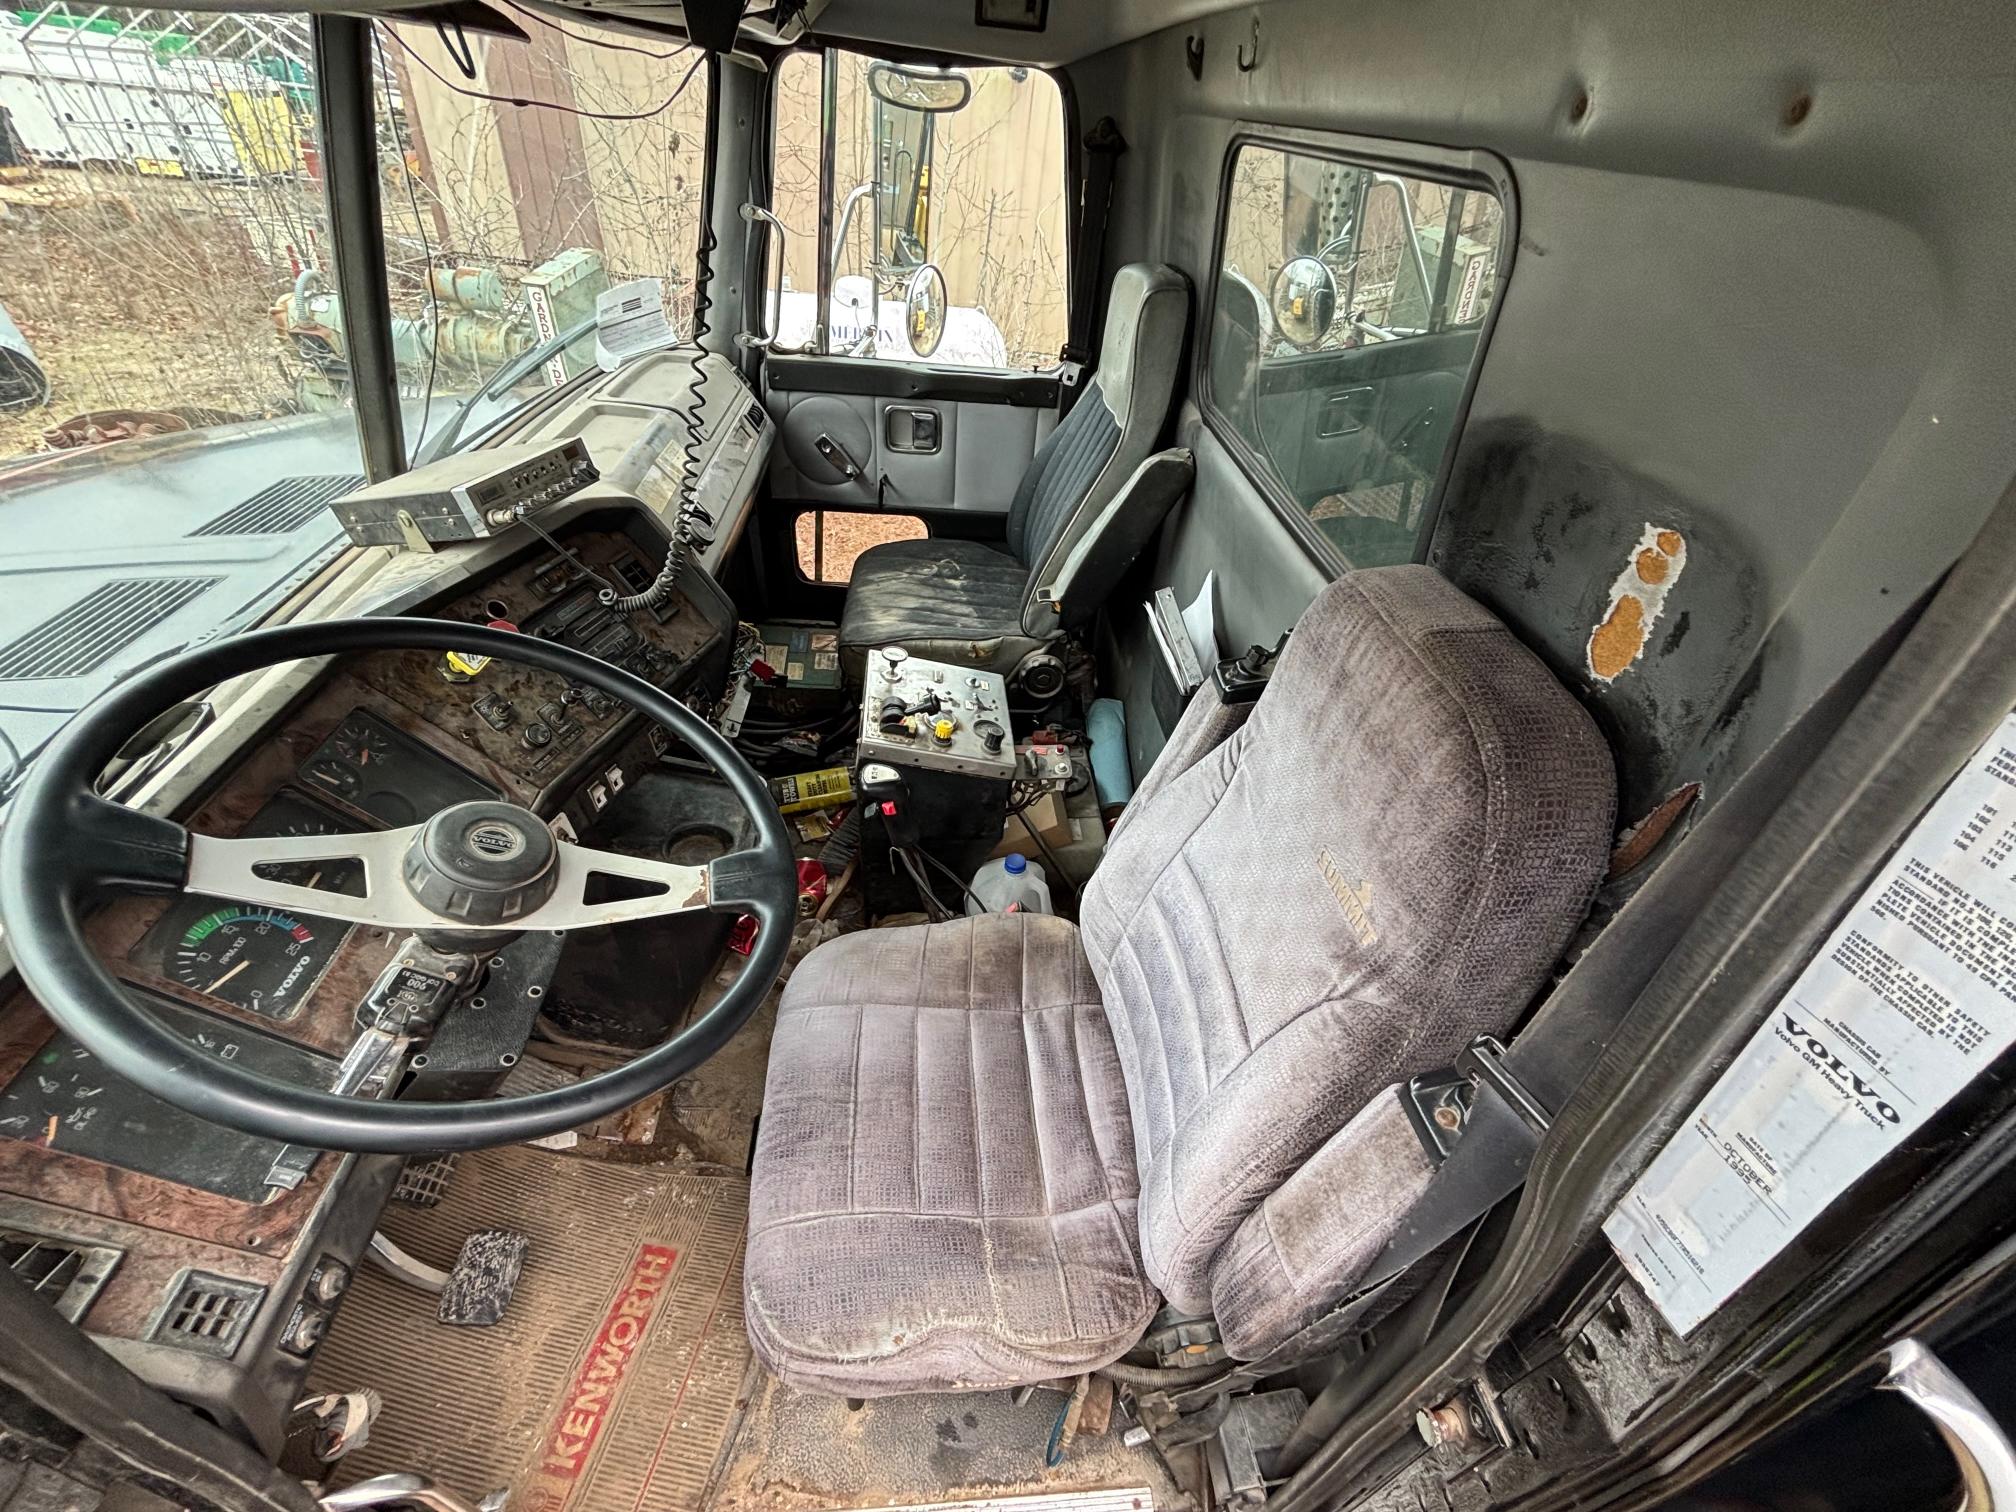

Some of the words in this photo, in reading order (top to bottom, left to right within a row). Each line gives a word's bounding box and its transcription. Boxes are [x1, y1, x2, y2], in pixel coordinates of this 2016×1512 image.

[1983, 763, 2016, 787] STAND
[1990, 753, 2016, 776] FEDE
[473, 836, 512, 847] VOLVO
[1310, 848, 1379, 948] SUMMIT
[1902, 863, 1951, 898] STANDARD
[1908, 856, 1930, 874] THIS
[1932, 872, 1971, 901] VEHICLE
[1972, 898, 1997, 918] WILL
[254, 919, 271, 937] 20
[1891, 877, 1949, 920] ACCORDANCE
[1950, 918, 1976, 939] WITH
[1976, 936, 1996, 953] THE
[1906, 920, 1951, 954] PURSUANT
[1951, 952, 1964, 964] TO
[1914, 904, 1963, 940] CONTAINED
[1964, 939, 1976, 950] IN
[1979, 950, 1998, 966] THE
[1937, 898, 1948, 908] IF
[1949, 906, 1961, 917] IT
[1962, 915, 1974, 926] IS
[1975, 924, 2016, 956] COMPLE
[195, 949, 212, 966] 10
[285, 940, 302, 958] 25
[1909, 911, 1946, 940] VEHICLE
[1948, 939, 2003, 980] DOCUMENT
[273, 952, 311, 1001] VOLVO
[1835, 947, 1897, 996] SUBSTANTIALLY
[1895, 994, 1938, 1028] AFFECTED
[1937, 1027, 1952, 1040] BY
[1952, 1039, 1971, 1055] THE
[1840, 941, 1871, 967] VEHICLE
[1871, 965, 1896, 986] WHEN
[1895, 984, 1945, 1024] COMPLETED
[1944, 1022, 1956, 1033] IS
[1957, 1032, 1978, 1050] NOT
[1844, 934, 1892, 973] STANDARDS
[1893, 972, 1944, 1013] APPLICABLE
[1945, 1012, 1959, 1025] TO
[1960, 1024, 1984, 1044] THIS
[1849, 928, 1904, 972] CONFORMITY
[1906, 971, 1919, 983] TO
[1920, 982, 1951, 1008] OTHER
[1953, 1007, 1991, 1038] SAFETY
[1867, 982, 1883, 996] THE
[1882, 994, 1917, 1022] CHASSIS
[1822, 1017, 1878, 1066] MANUFACTURED
[1837, 1020, 1867, 1046] CHASSIS
[1772, 1026, 1802, 1054] Volvo
[1800, 1051, 1821, 1070] GM
[1818, 1068, 1854, 1102] Heavy
[1852, 1099, 1887, 1131] Truck
[1782, 1012, 1901, 1124] VOLVO
[1719, 1141, 1775, 1195] OCTOBER
[1721, 1154, 1754, 1185] 1995
[541, 1253, 668, 1469] KENWORTH
